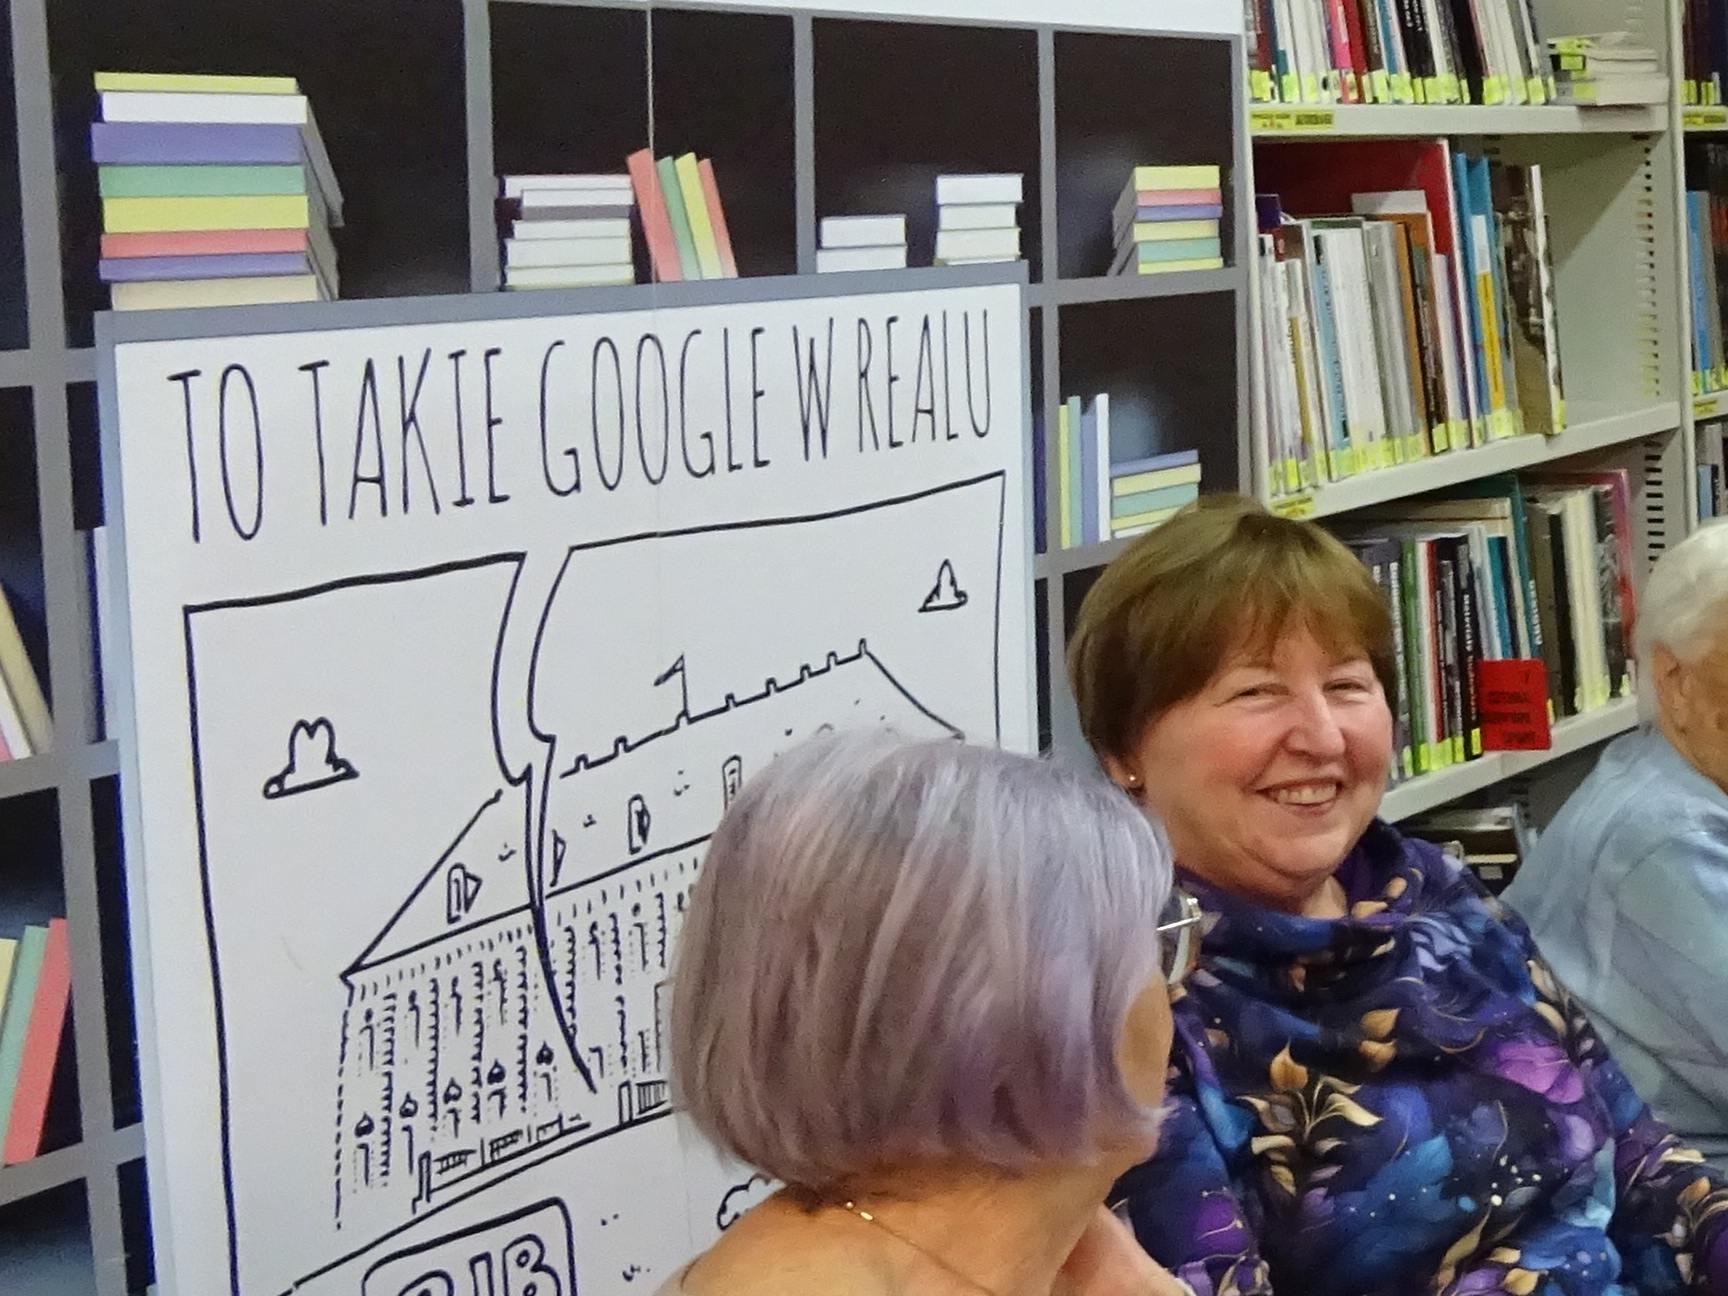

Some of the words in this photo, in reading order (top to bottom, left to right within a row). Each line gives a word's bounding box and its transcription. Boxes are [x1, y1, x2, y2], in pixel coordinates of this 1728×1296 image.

[167, 360, 265, 543] TO
[299, 345, 511, 527] TAKIE
[539, 324, 772, 499] GOOGLE
[791, 316, 837, 462] W
[855, 308, 993, 453] REALU
